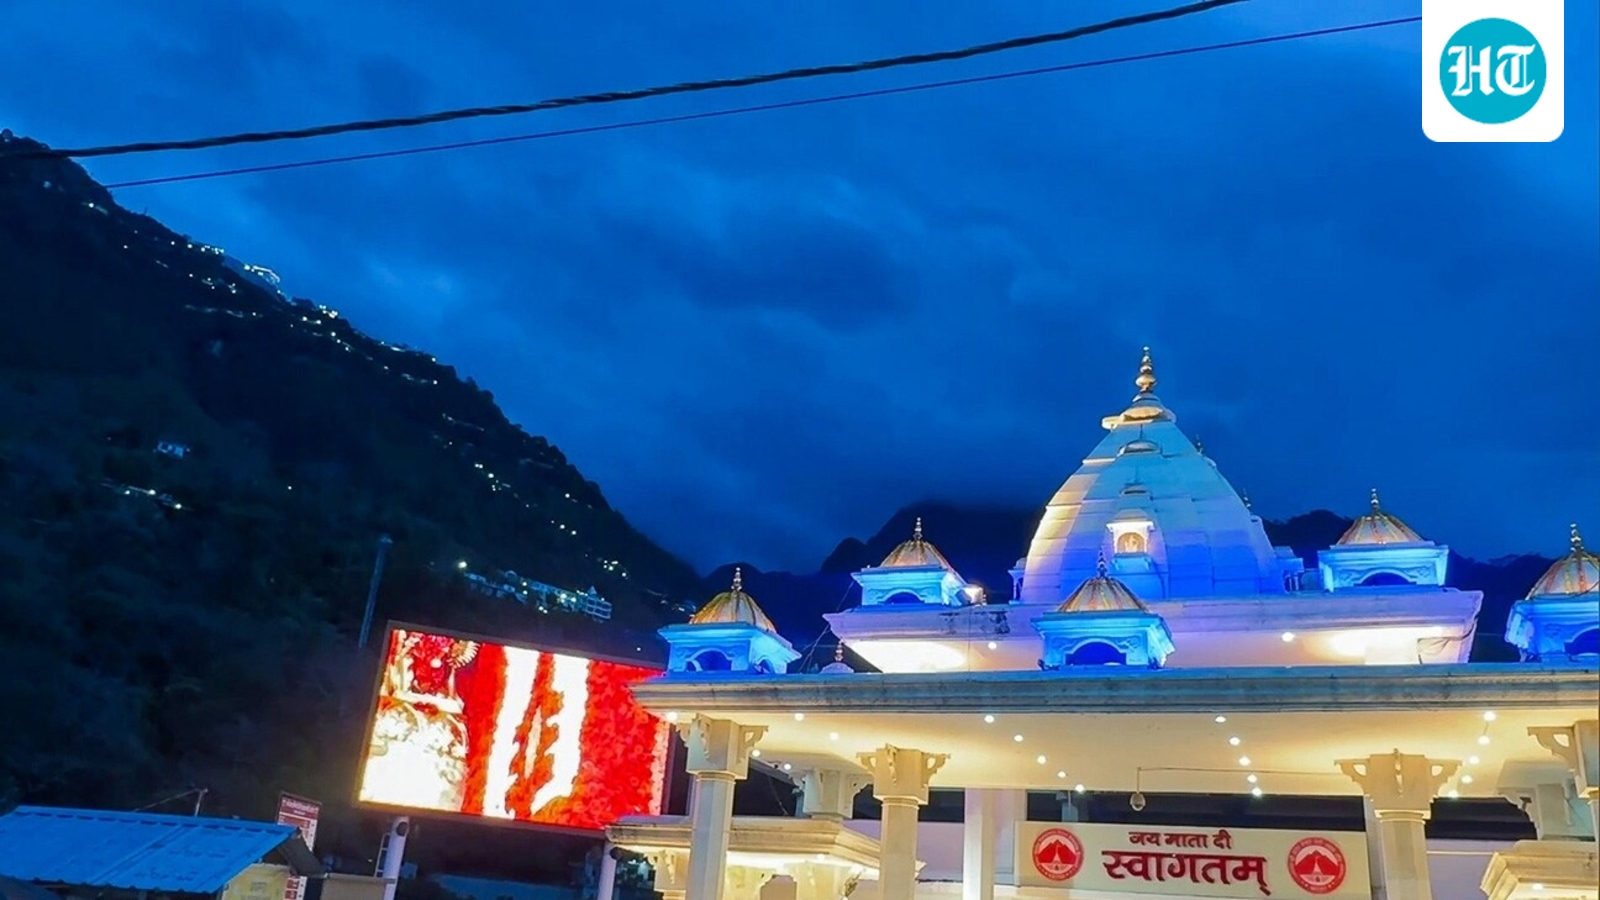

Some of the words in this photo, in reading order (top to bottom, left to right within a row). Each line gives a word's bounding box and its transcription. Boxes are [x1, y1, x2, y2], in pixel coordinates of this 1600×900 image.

[1128, 831, 1160, 846] जय
[1163, 833, 1208, 848] माता
[1212, 829, 1232, 849] दी
[1101, 850, 1271, 896] स्वागतम्
